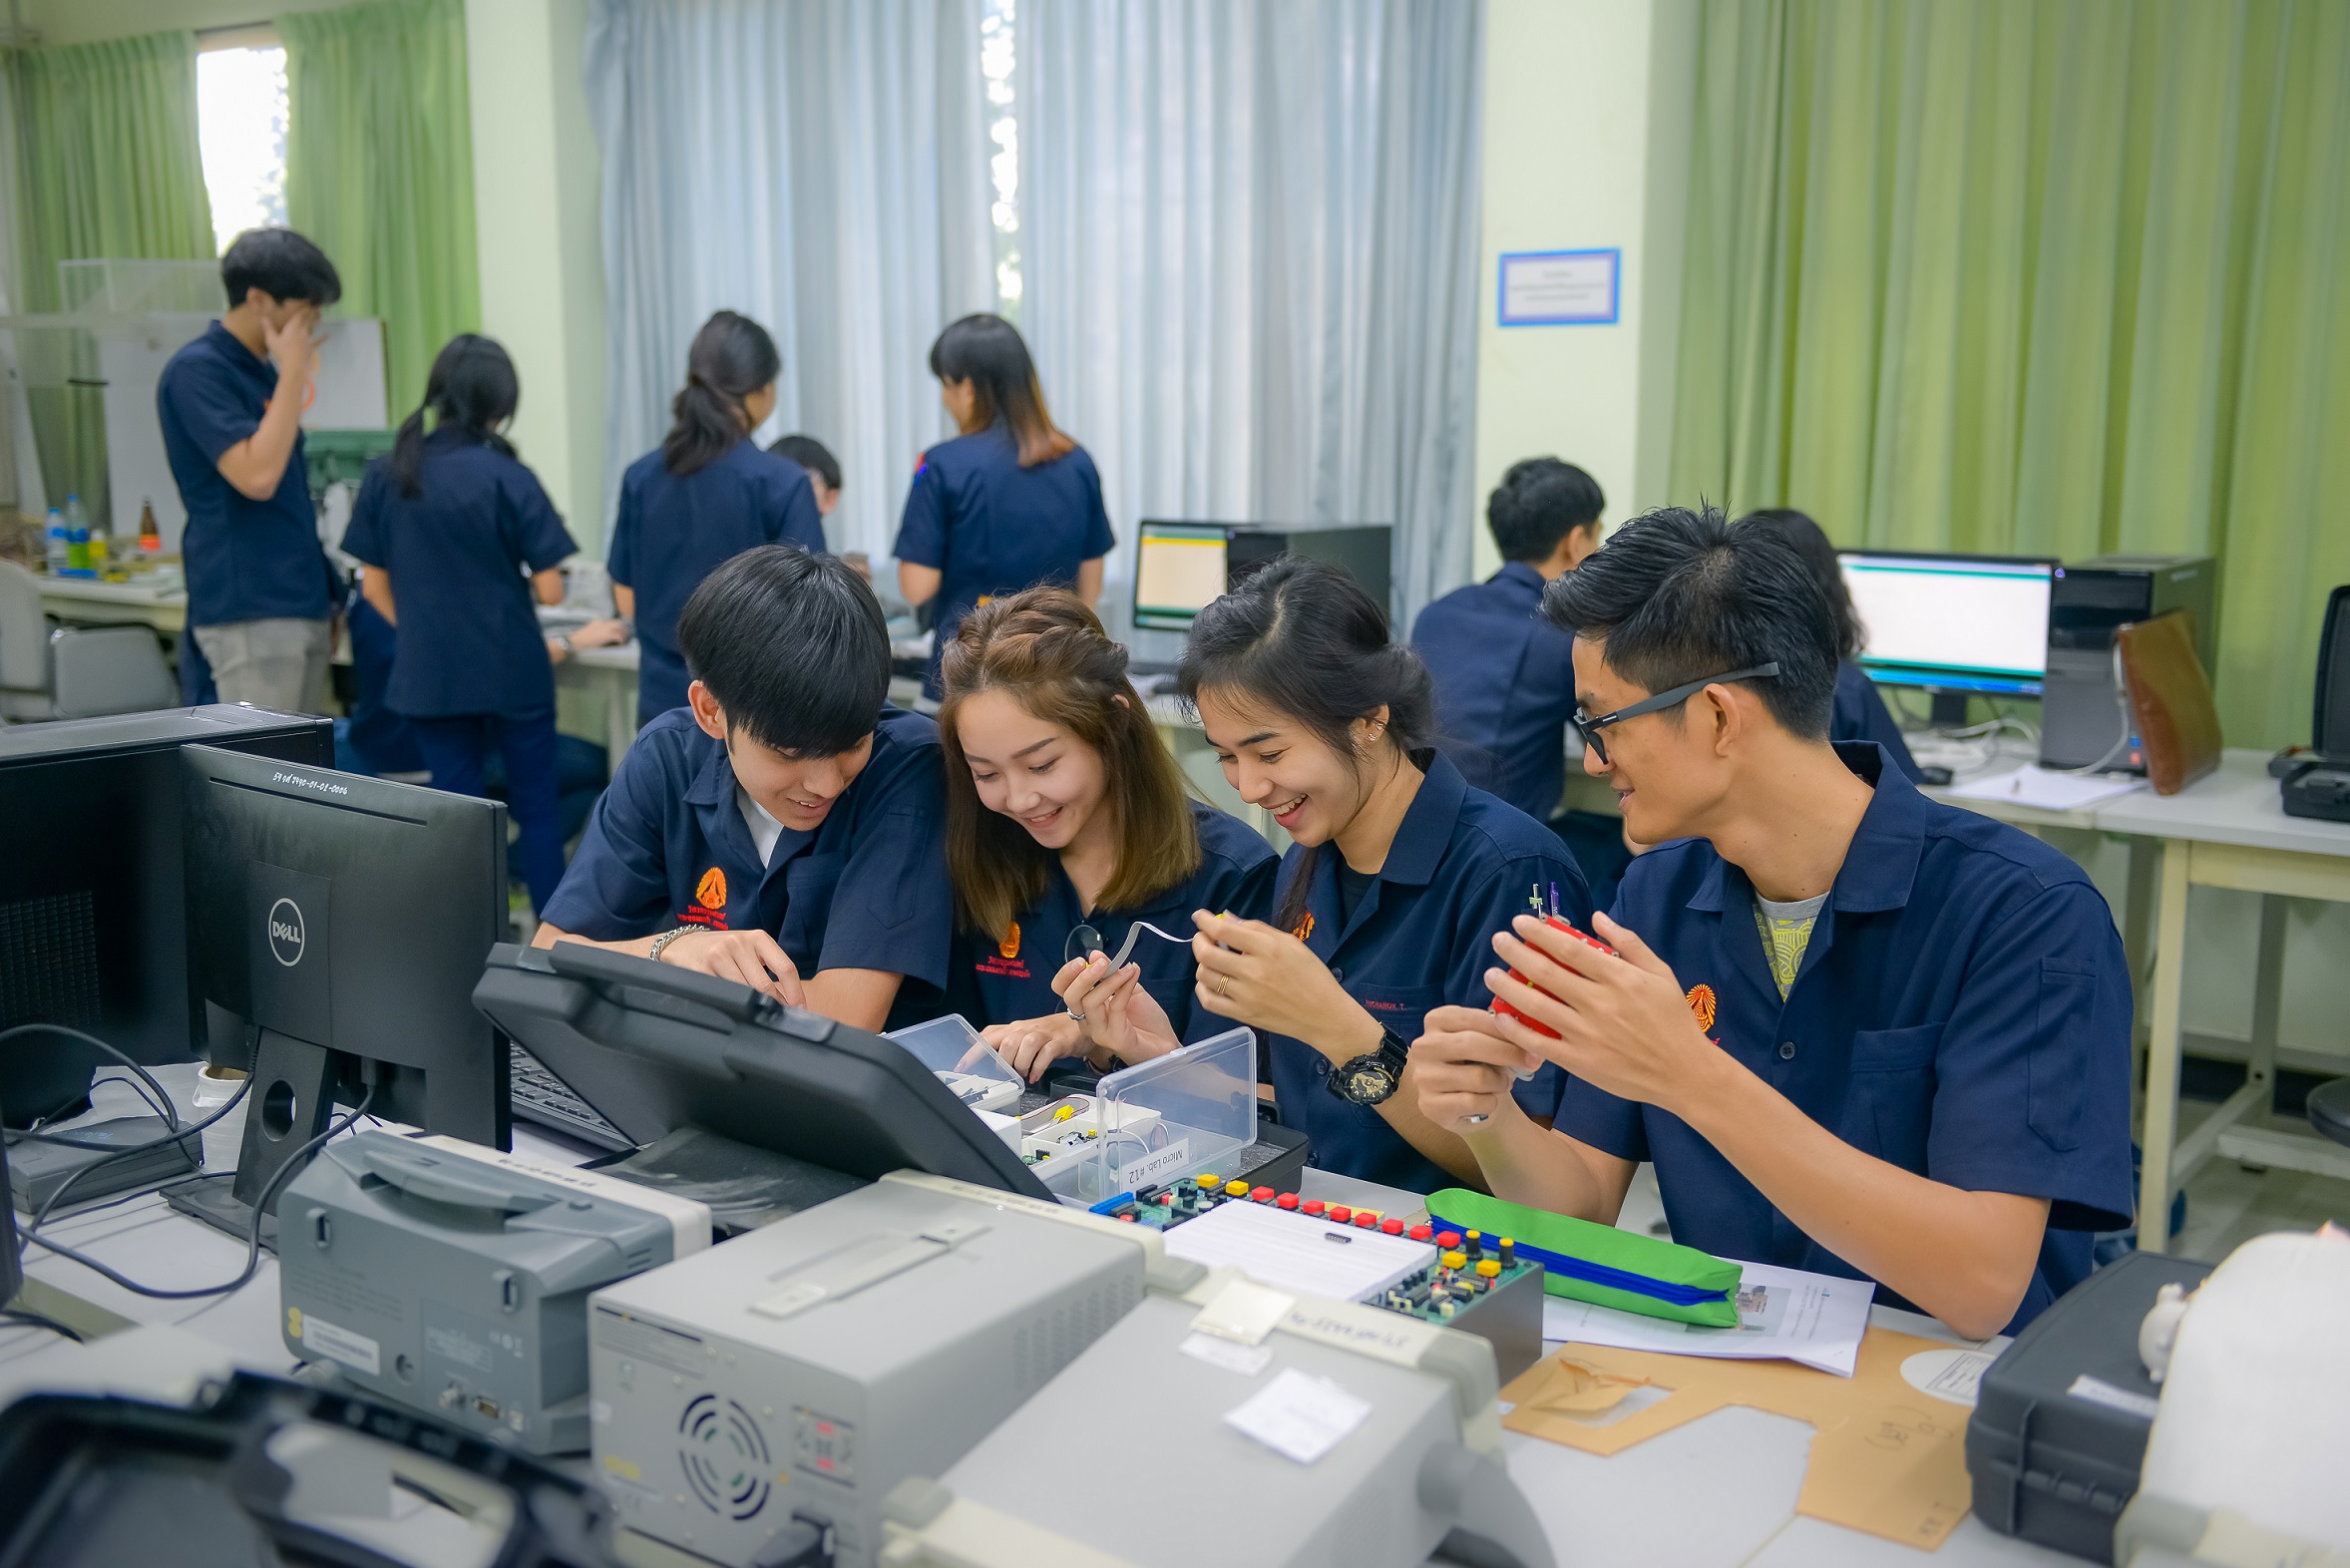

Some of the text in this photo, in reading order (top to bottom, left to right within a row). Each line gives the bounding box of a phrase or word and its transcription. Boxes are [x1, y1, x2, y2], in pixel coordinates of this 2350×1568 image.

[272, 921, 301, 944] DELL
[1128, 1149, 1183, 1184] Micro Lab. #12
